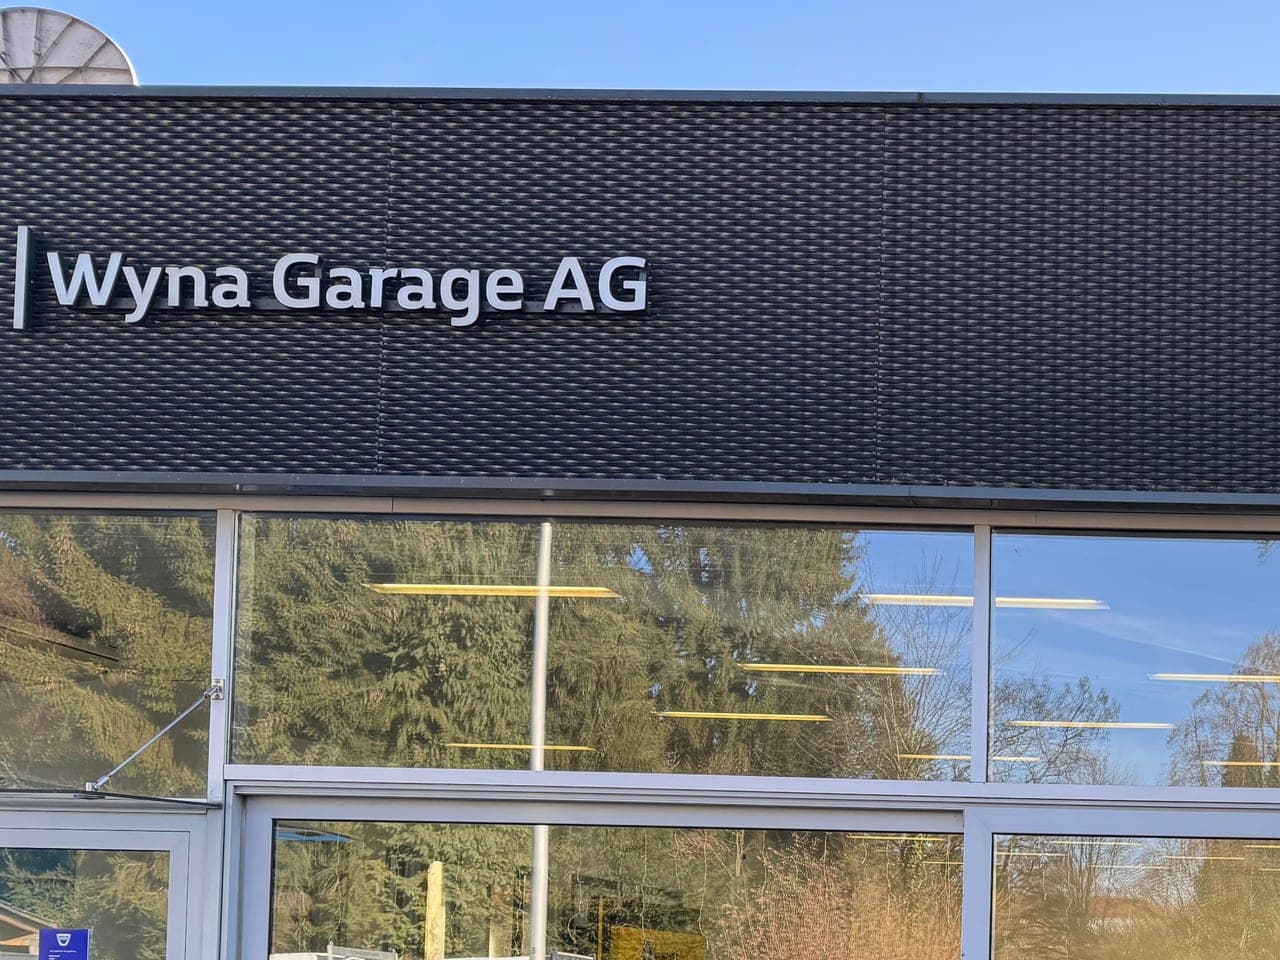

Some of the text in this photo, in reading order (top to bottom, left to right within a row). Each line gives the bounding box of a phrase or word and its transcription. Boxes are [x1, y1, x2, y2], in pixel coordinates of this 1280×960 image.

[46, 250, 648, 327] Wyna Garage AG
